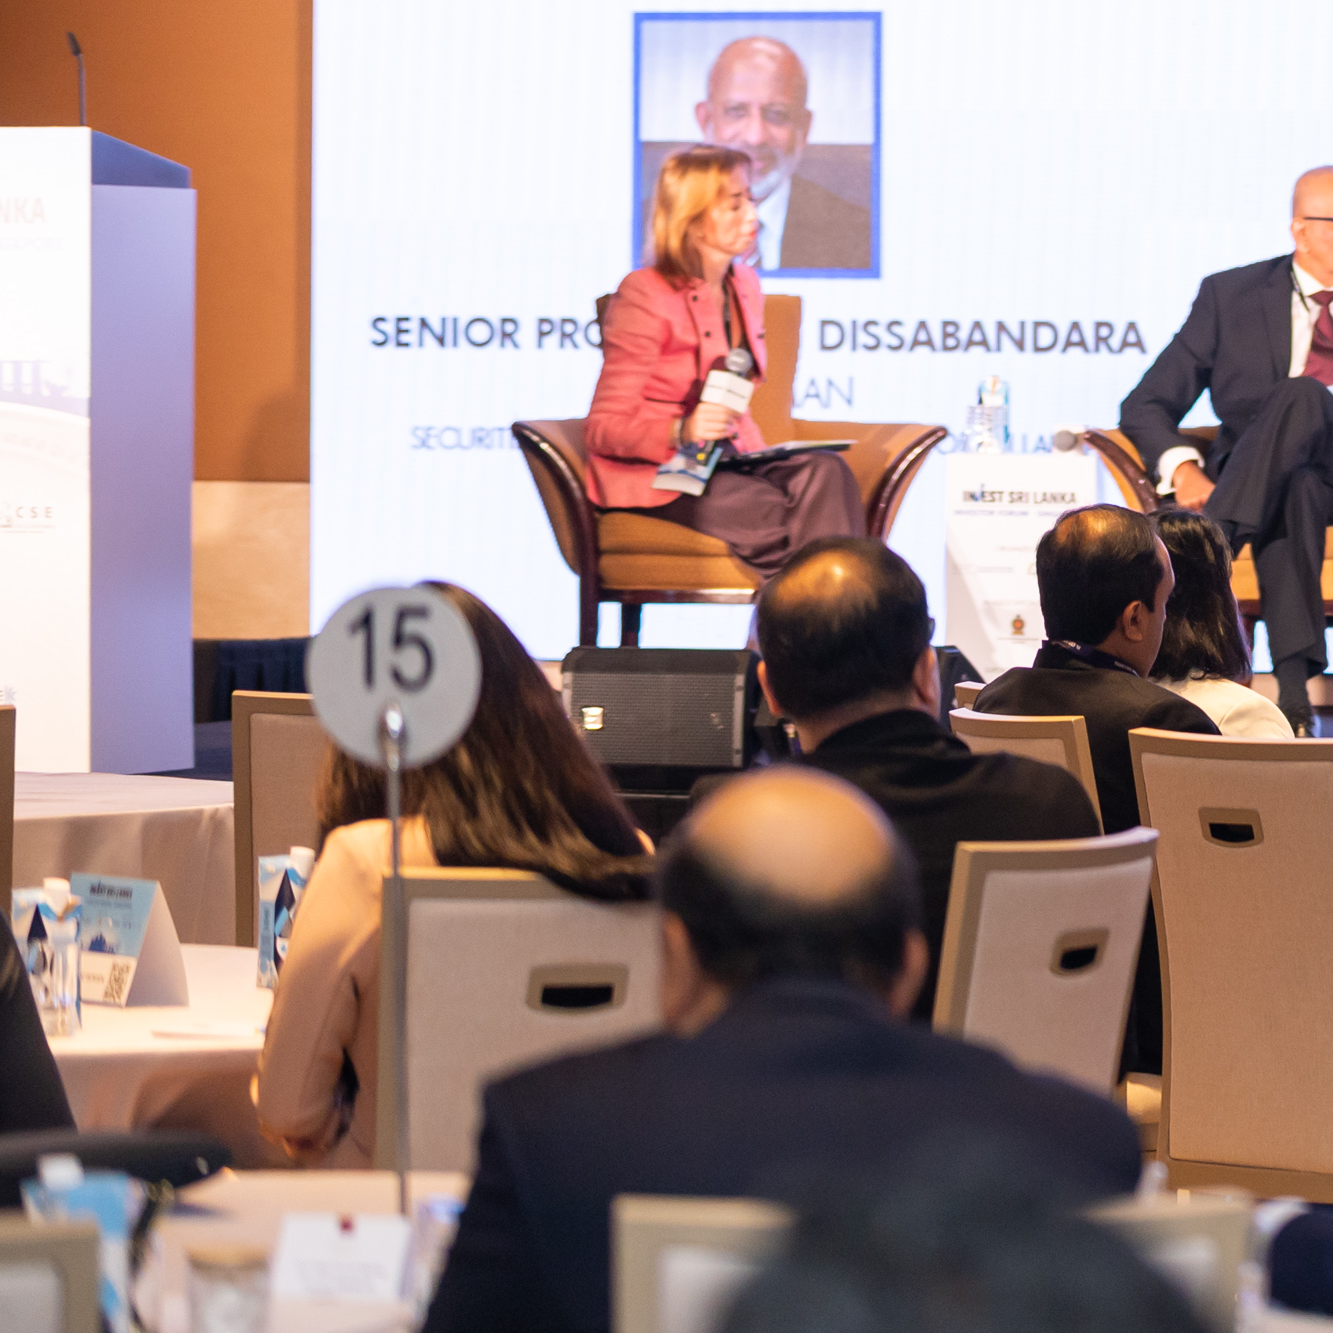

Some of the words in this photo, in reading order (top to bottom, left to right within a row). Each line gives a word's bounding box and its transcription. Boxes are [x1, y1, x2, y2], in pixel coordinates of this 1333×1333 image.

[0, 197, 46, 224] NKA
[371, 317, 520, 349] SENIOR
[537, 318, 603, 349] PRO
[819, 319, 1147, 354] DISSABANDARA
[410, 426, 522, 450] SECURIT
[963, 487, 1004, 503] INVEST
[1009, 491, 1029, 504] SRI
[1033, 491, 1077, 505] LANKA
[348, 603, 434, 693] 15
